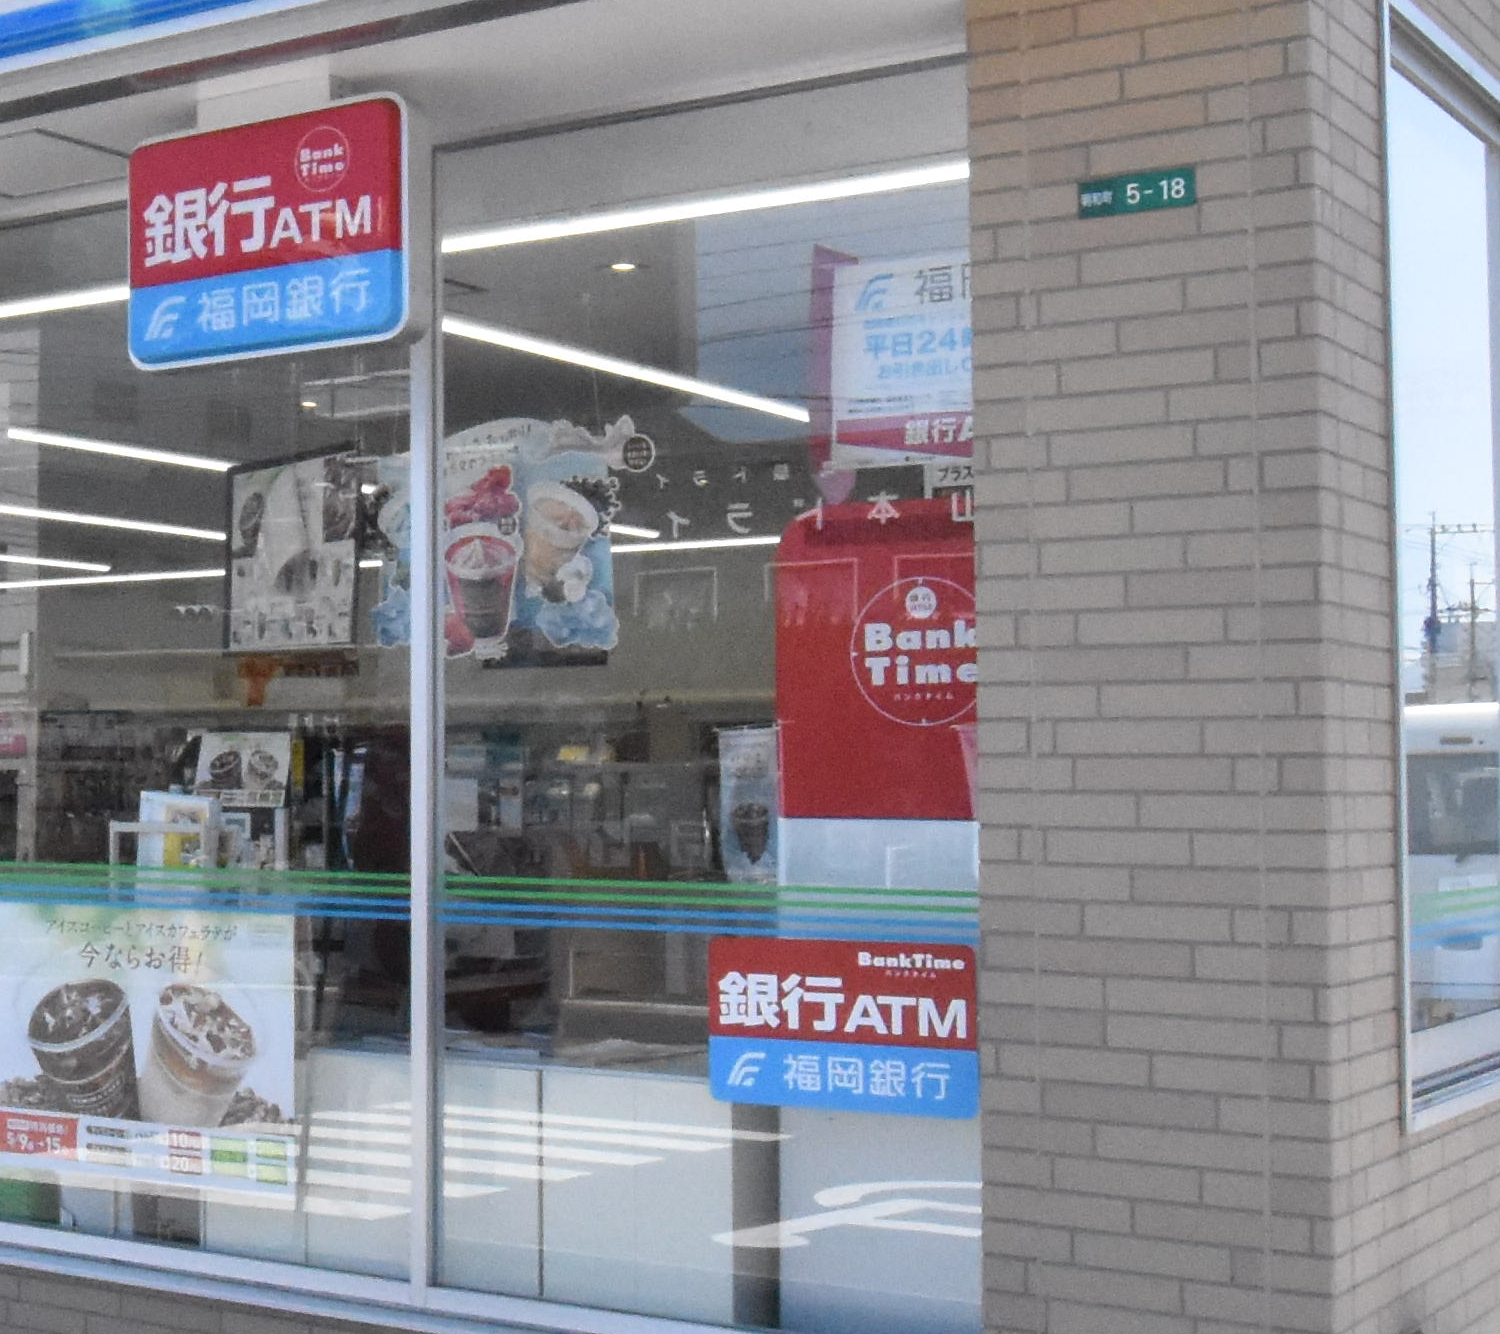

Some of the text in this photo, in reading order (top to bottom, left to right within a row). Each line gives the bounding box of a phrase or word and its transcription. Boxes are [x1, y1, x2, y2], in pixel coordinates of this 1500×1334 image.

[300, 143, 344, 163] Bank
[300, 161, 345, 177] Time
[1126, 177, 1185, 205] 5-18
[143, 174, 372, 268] 銀行ATM
[196, 267, 372, 334] 福岡銀行
[864, 619, 977, 652] Bank
[864, 655, 979, 686] Time
[857, 951, 966, 970] BankTime
[717, 970, 968, 1040] 銀行ATM
[783, 1053, 951, 1101] 福岡銀行
